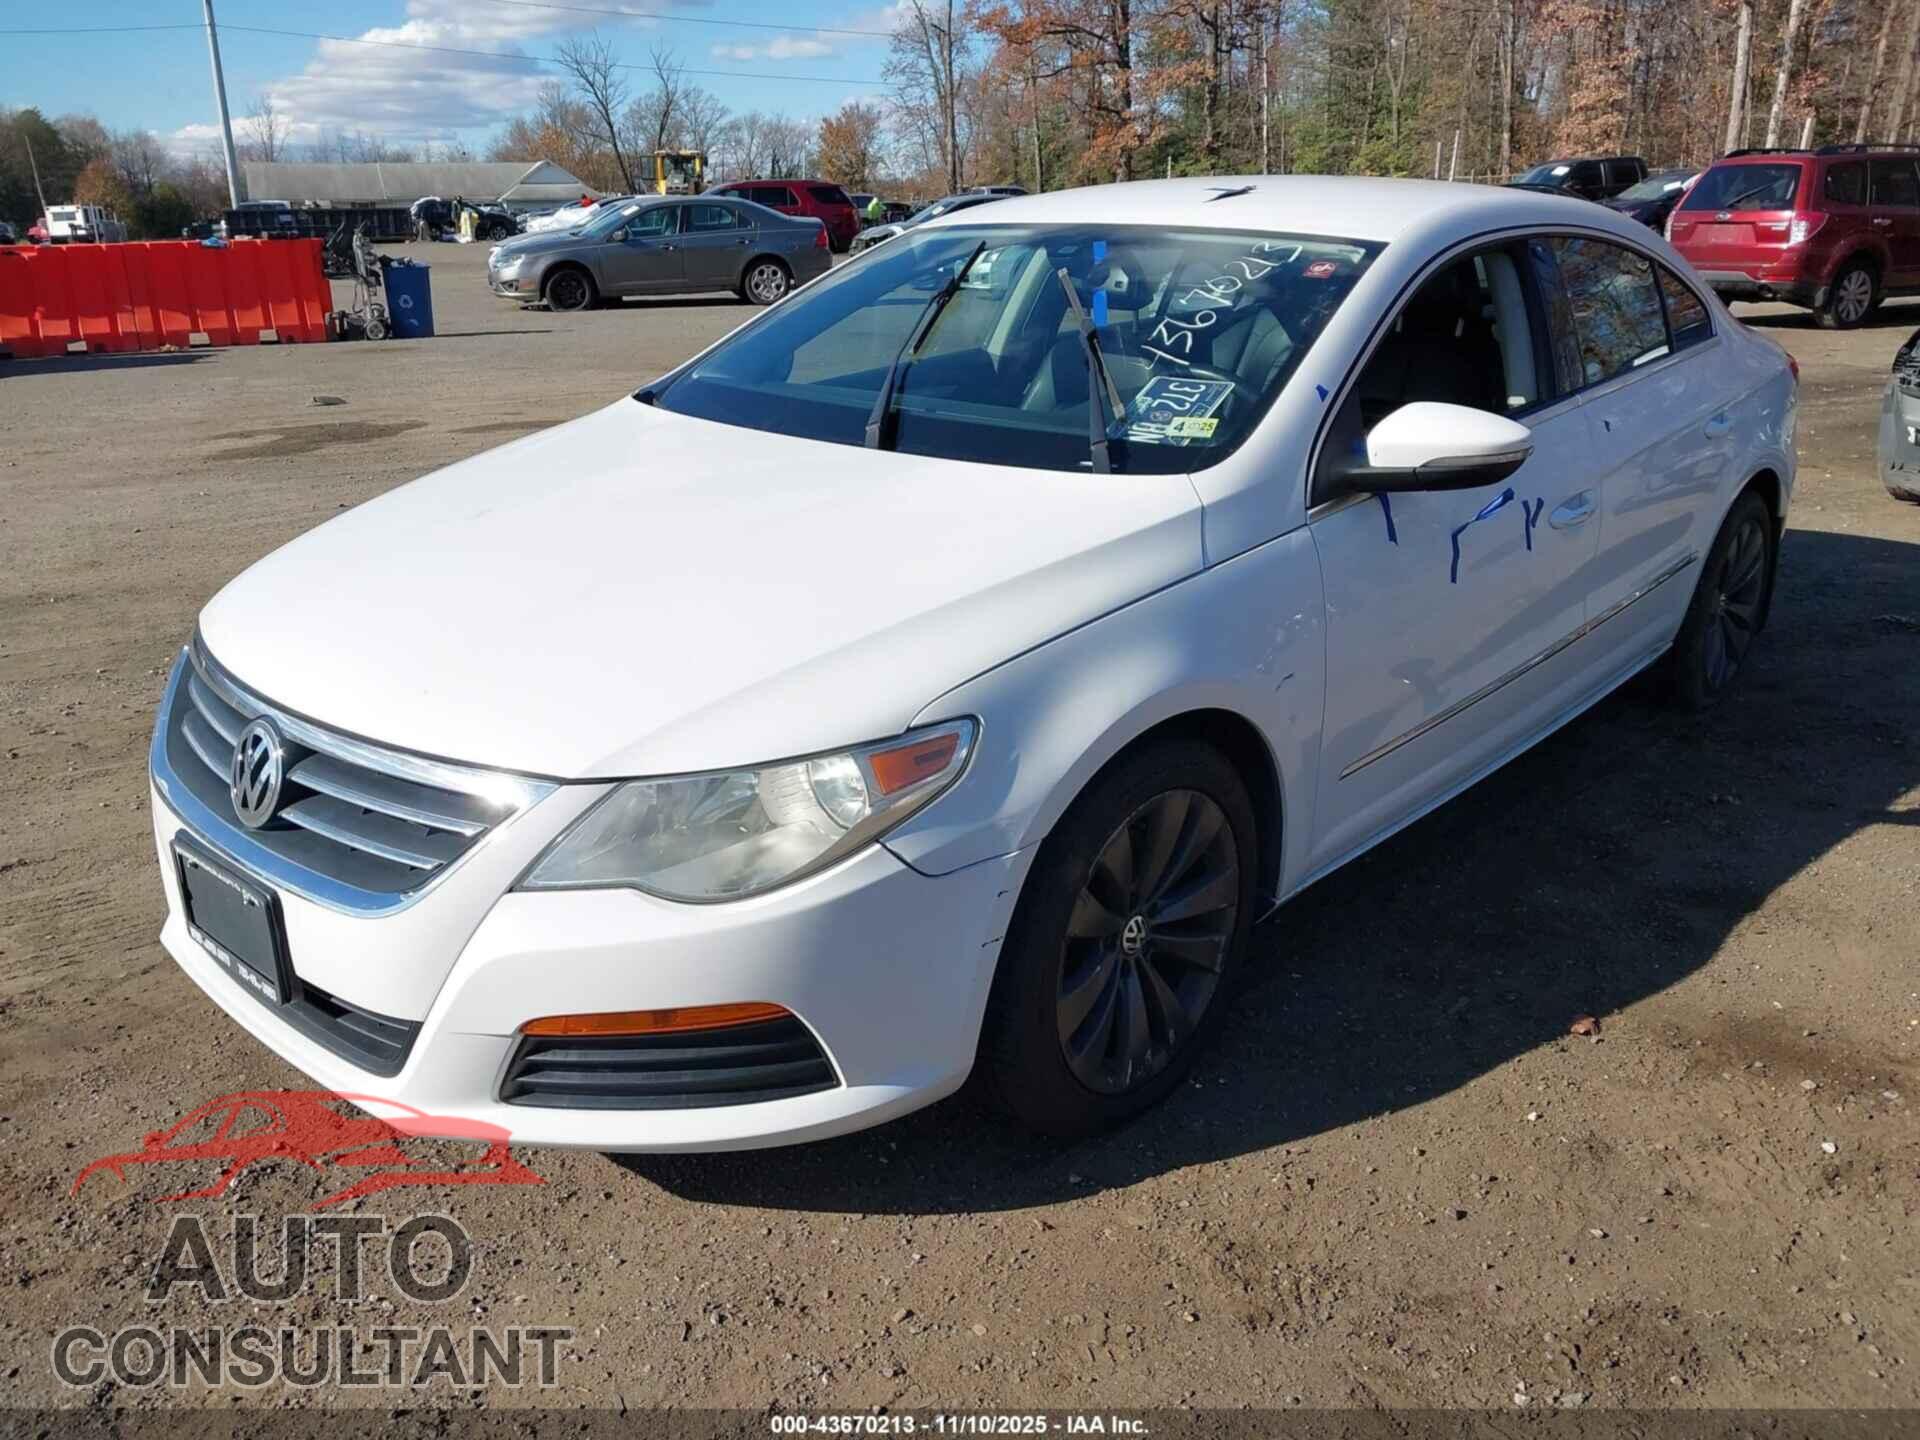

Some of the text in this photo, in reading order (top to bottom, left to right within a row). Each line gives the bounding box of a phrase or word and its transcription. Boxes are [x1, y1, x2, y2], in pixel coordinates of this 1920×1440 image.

[1152, 382, 1207, 411] 372
[1173, 421, 1186, 433] 4
[1199, 422, 1215, 432] 25
